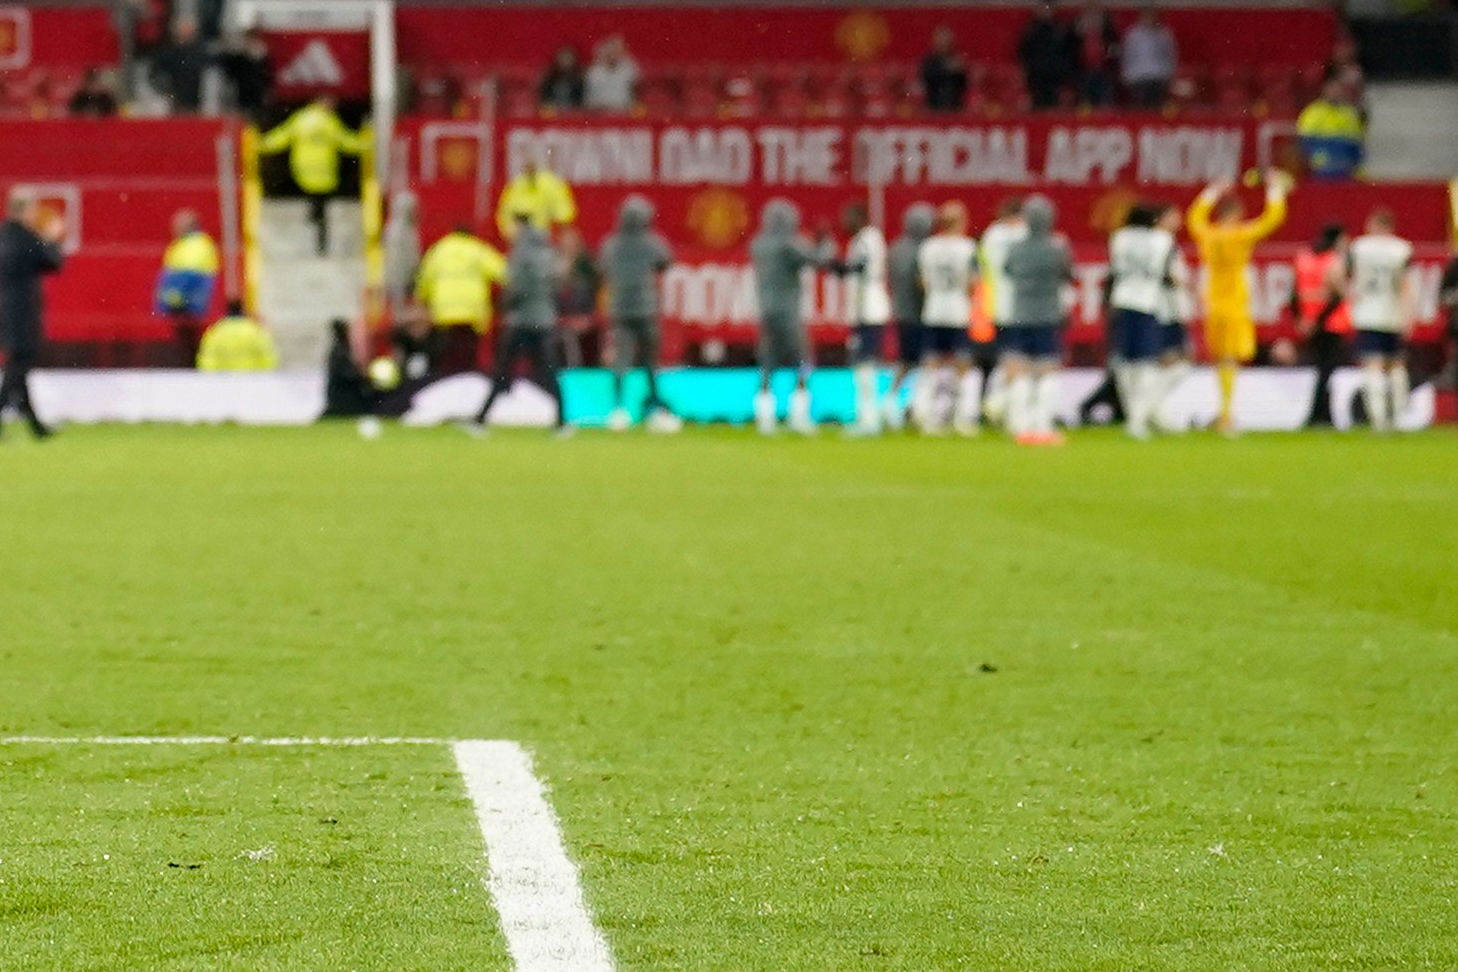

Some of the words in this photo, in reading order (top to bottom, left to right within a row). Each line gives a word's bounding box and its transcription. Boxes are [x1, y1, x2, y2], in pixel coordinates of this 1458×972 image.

[758, 126, 841, 185] THE
[852, 126, 1031, 186] OFFICIAL
[1045, 126, 1134, 186] APP
[1138, 126, 1243, 186] NOW
